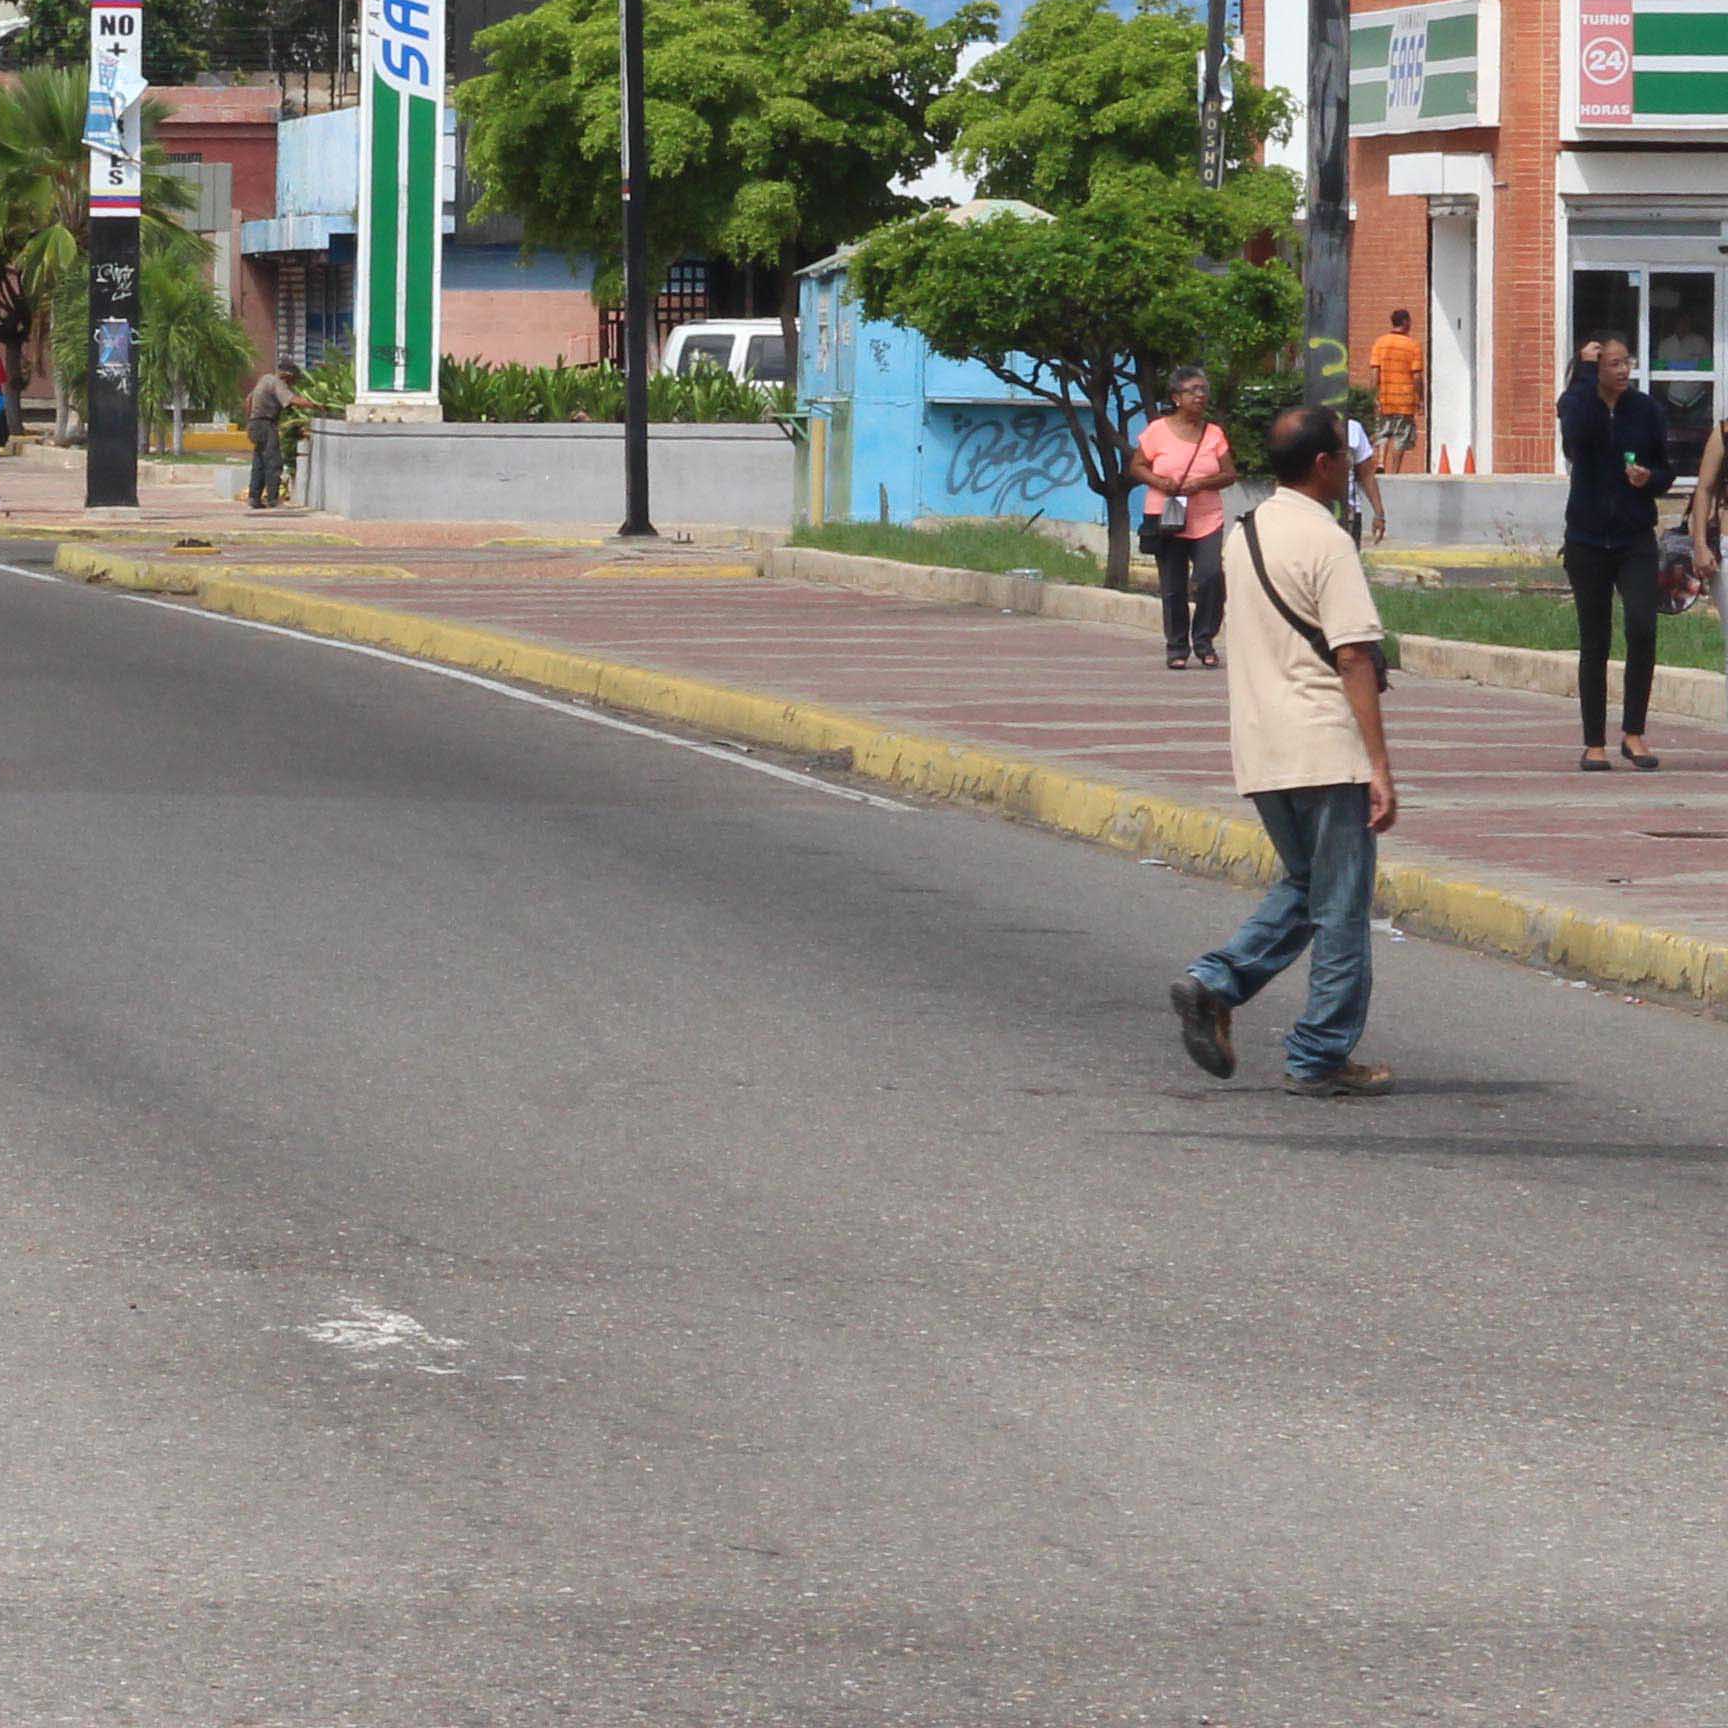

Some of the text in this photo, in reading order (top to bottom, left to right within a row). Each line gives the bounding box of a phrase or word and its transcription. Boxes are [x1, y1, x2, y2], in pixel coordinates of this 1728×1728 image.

[100, 14, 134, 37] NO
[1581, 13, 1630, 26] TURNO
[1588, 49, 1624, 70] 24
[1580, 104, 1630, 117] HORAS
